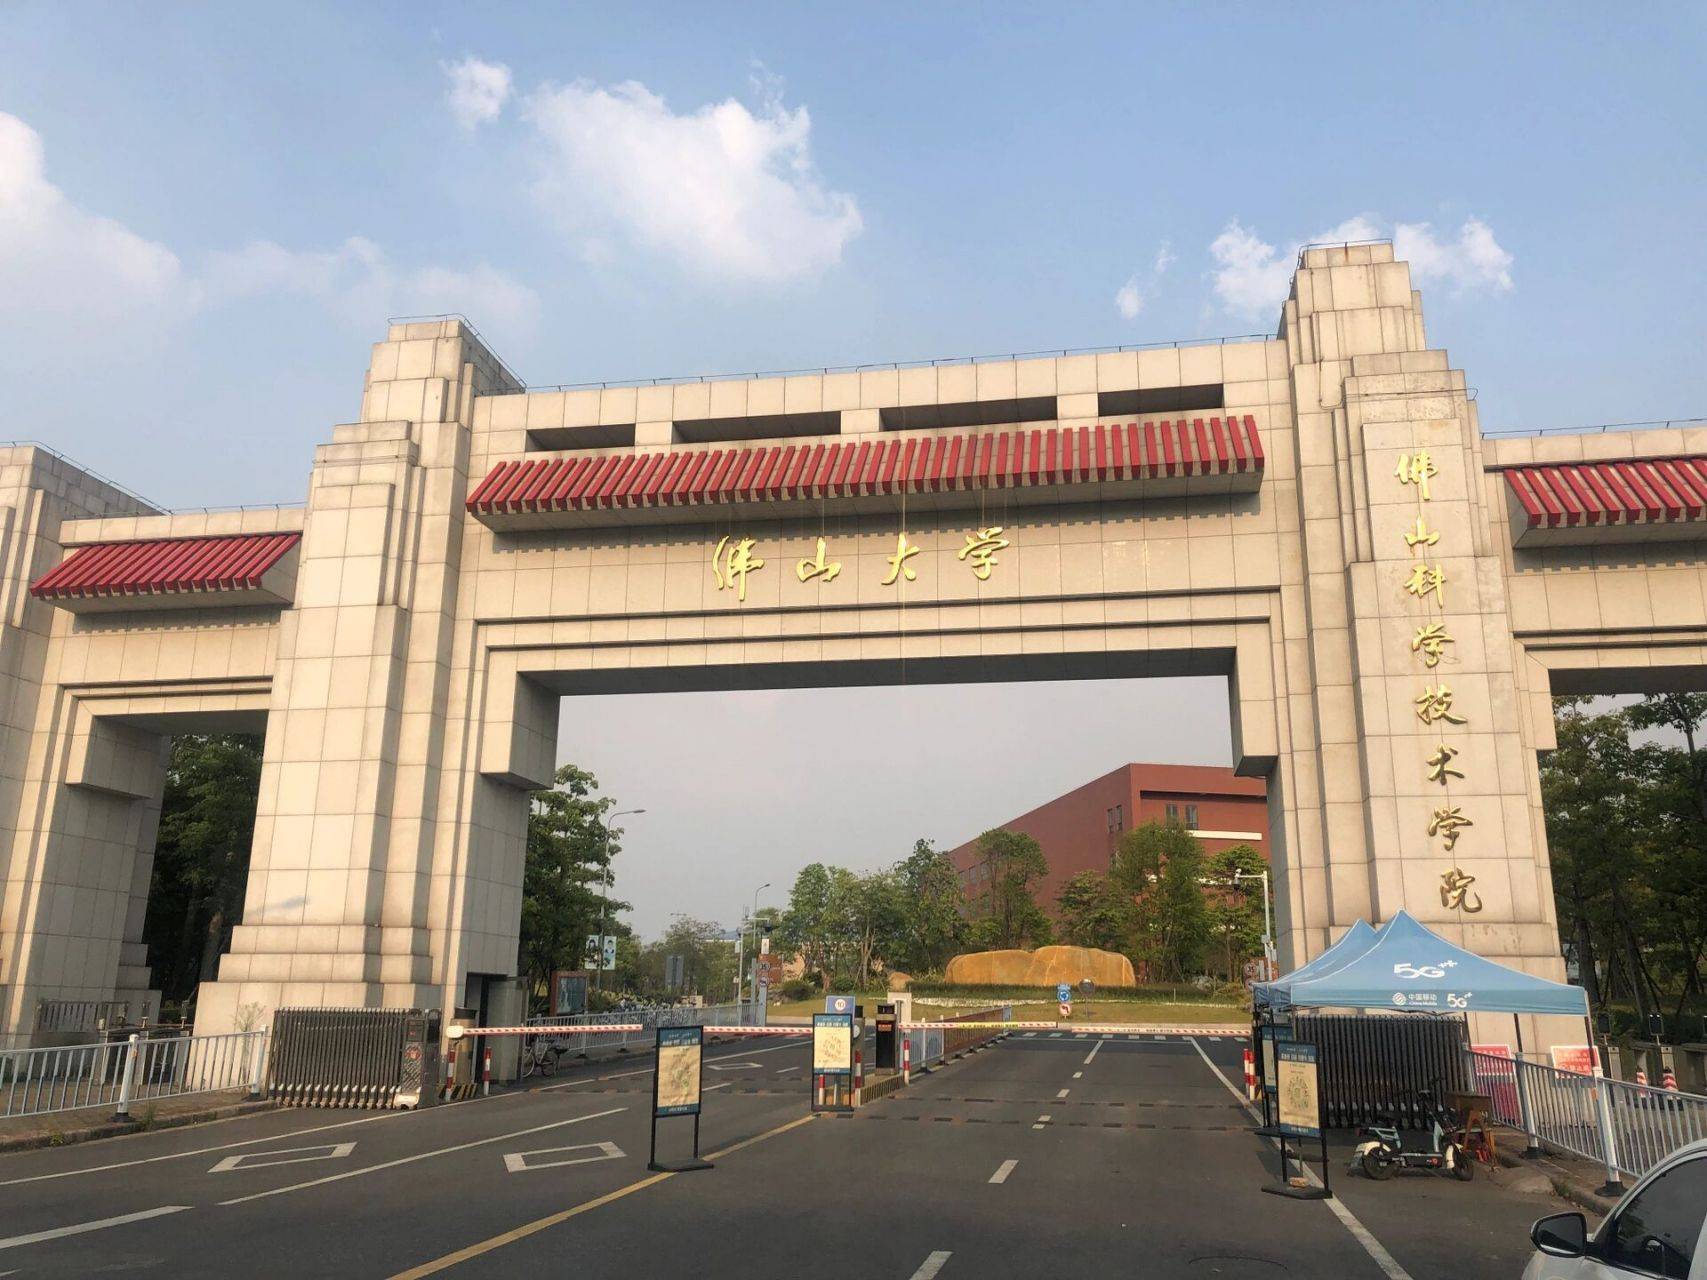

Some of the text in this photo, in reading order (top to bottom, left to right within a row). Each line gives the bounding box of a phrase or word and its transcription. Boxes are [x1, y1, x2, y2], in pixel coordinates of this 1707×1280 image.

[712, 526, 1010, 601] 佛山大学
[1394, 448, 1483, 914] 佛山科学技术学院
